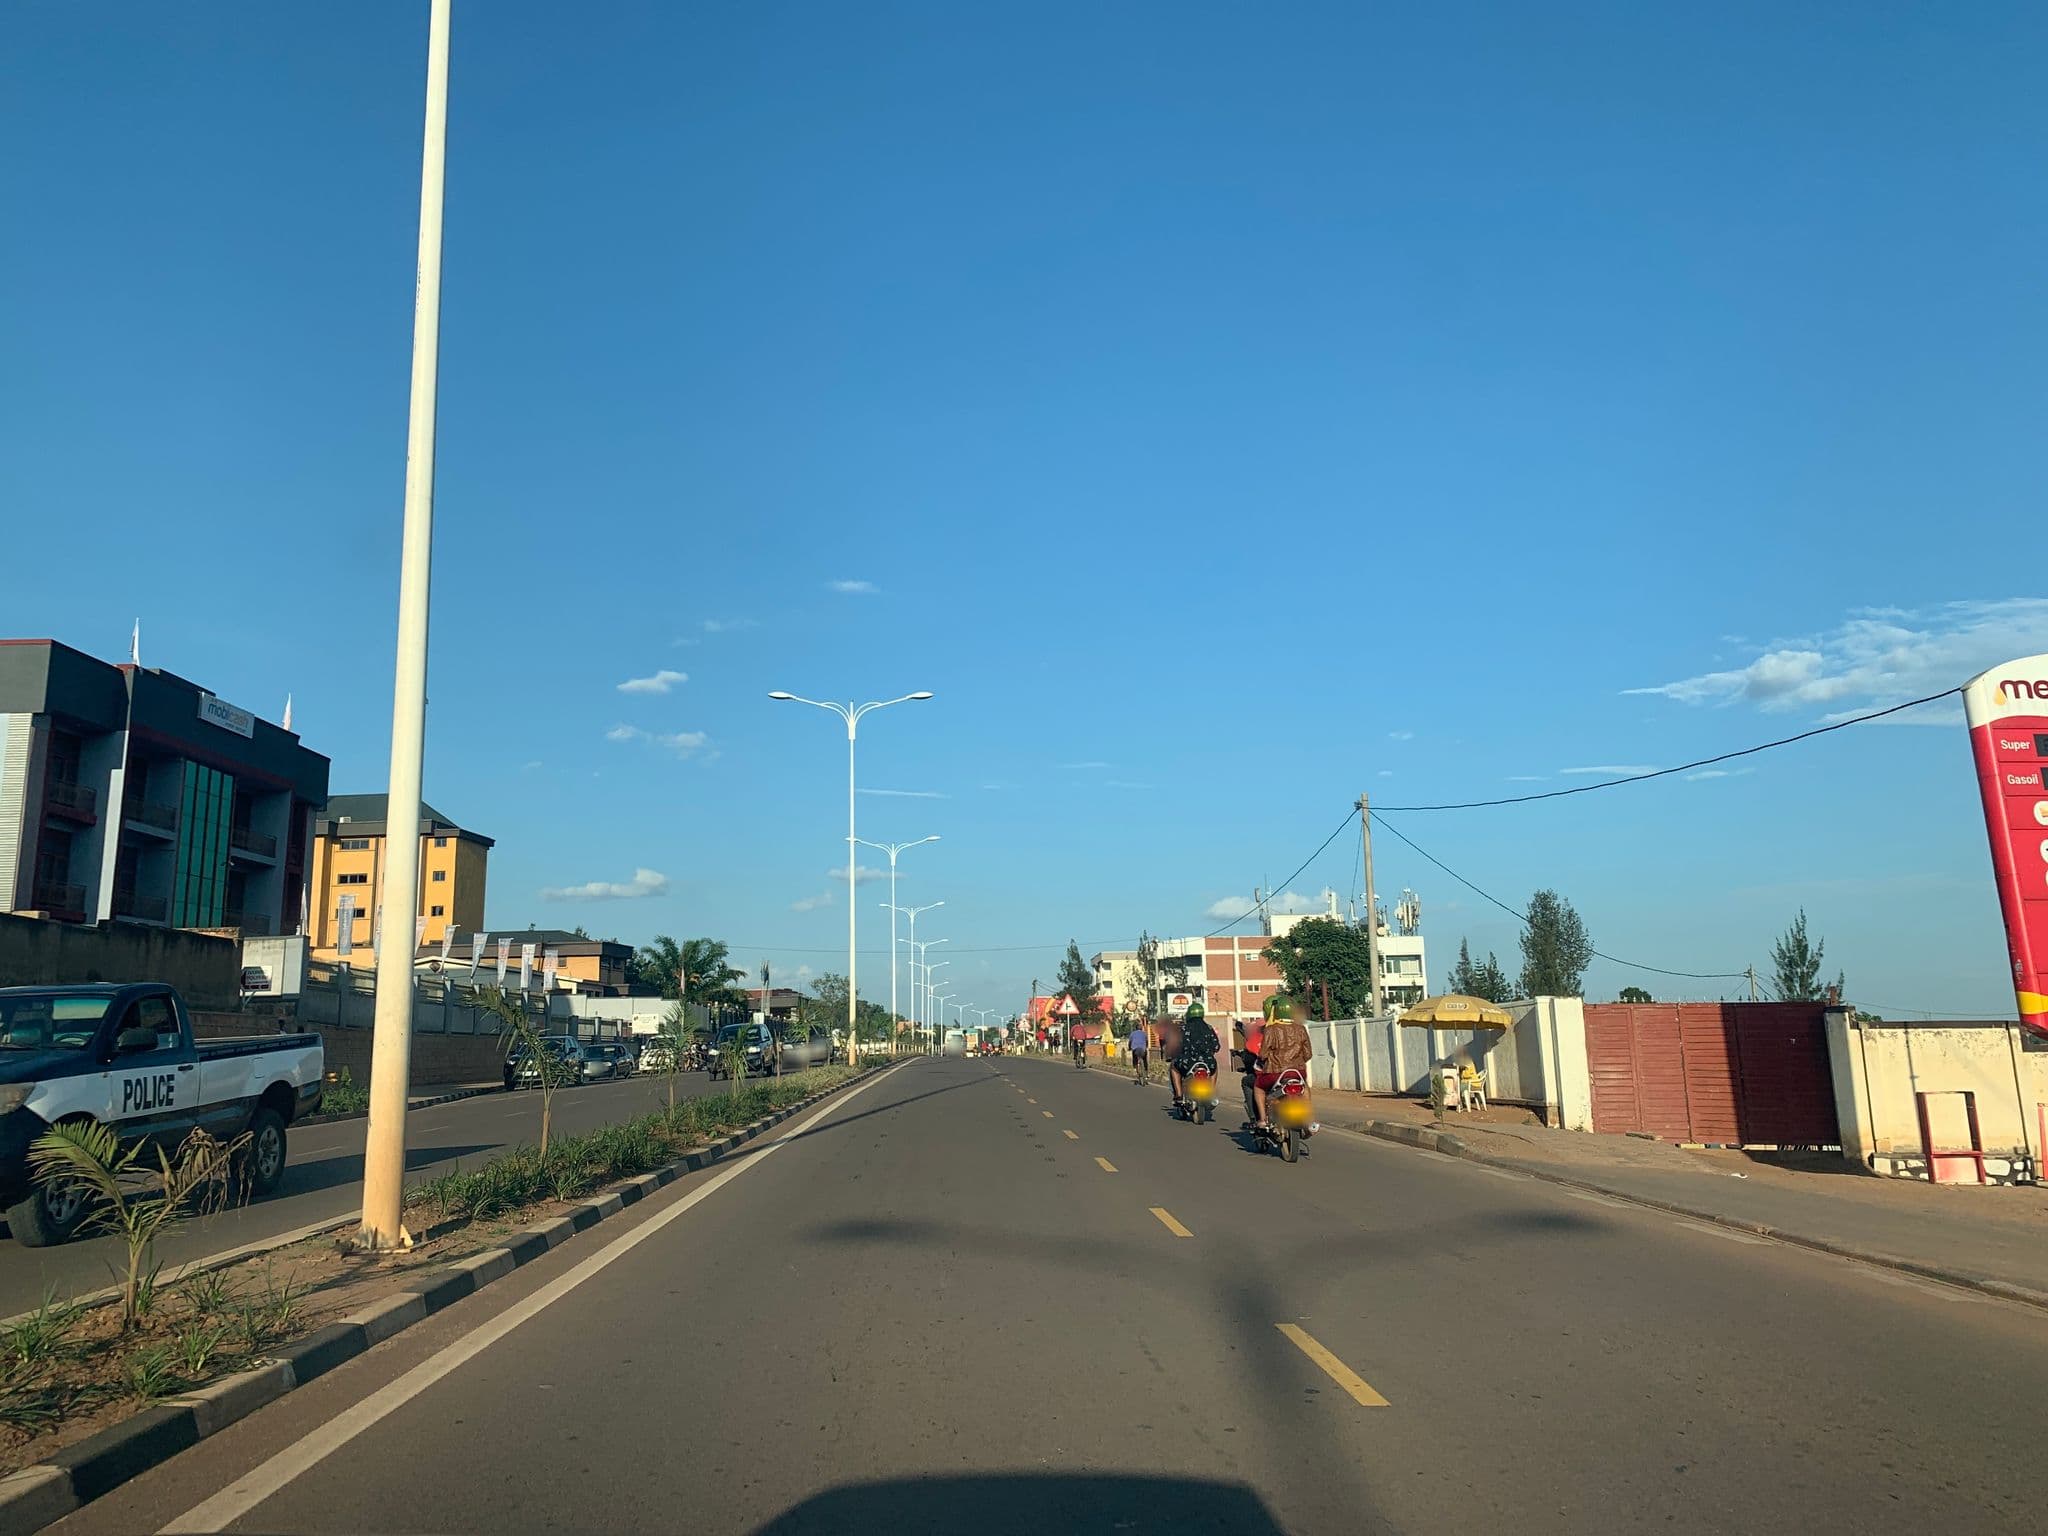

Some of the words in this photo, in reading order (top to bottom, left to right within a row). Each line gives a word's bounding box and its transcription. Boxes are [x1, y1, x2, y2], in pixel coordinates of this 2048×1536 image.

[2000, 739, 2030, 751] Super
[2007, 774, 2039, 785] Gasoil
[123, 1074, 175, 1113] POLICE
